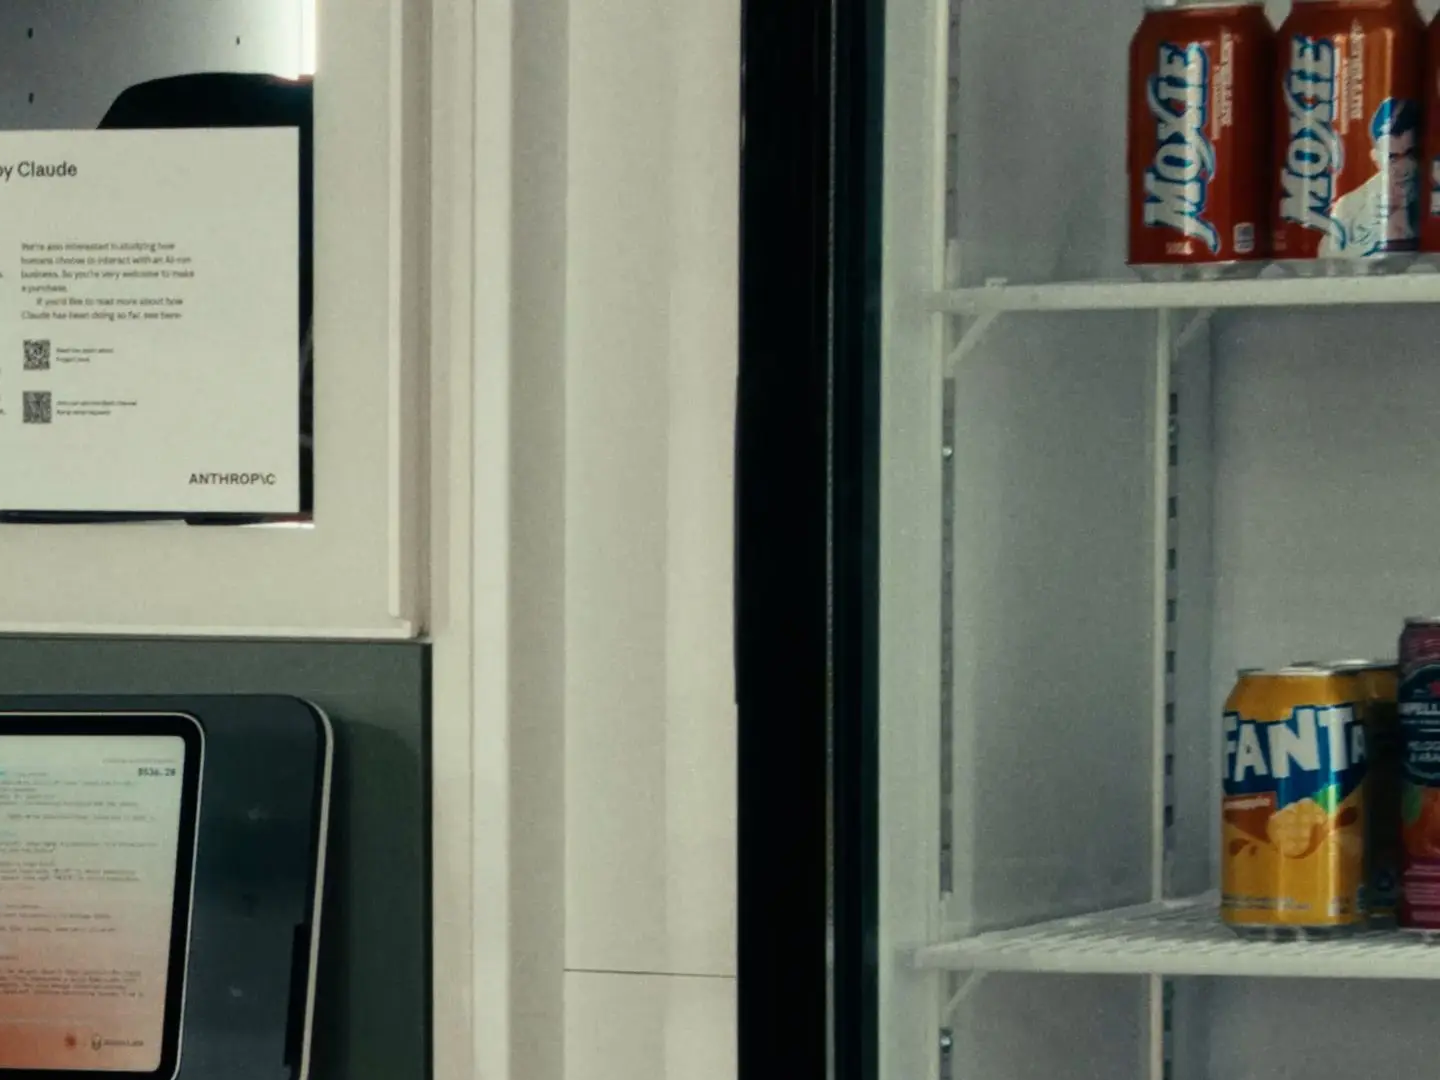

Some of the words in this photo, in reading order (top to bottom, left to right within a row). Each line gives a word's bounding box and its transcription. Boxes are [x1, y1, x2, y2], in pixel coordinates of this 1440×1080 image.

[16, 160, 78, 178] Claude
[1143, 41, 1220, 255] MOXIE
[1280, 34, 1347, 251] MOXIE
